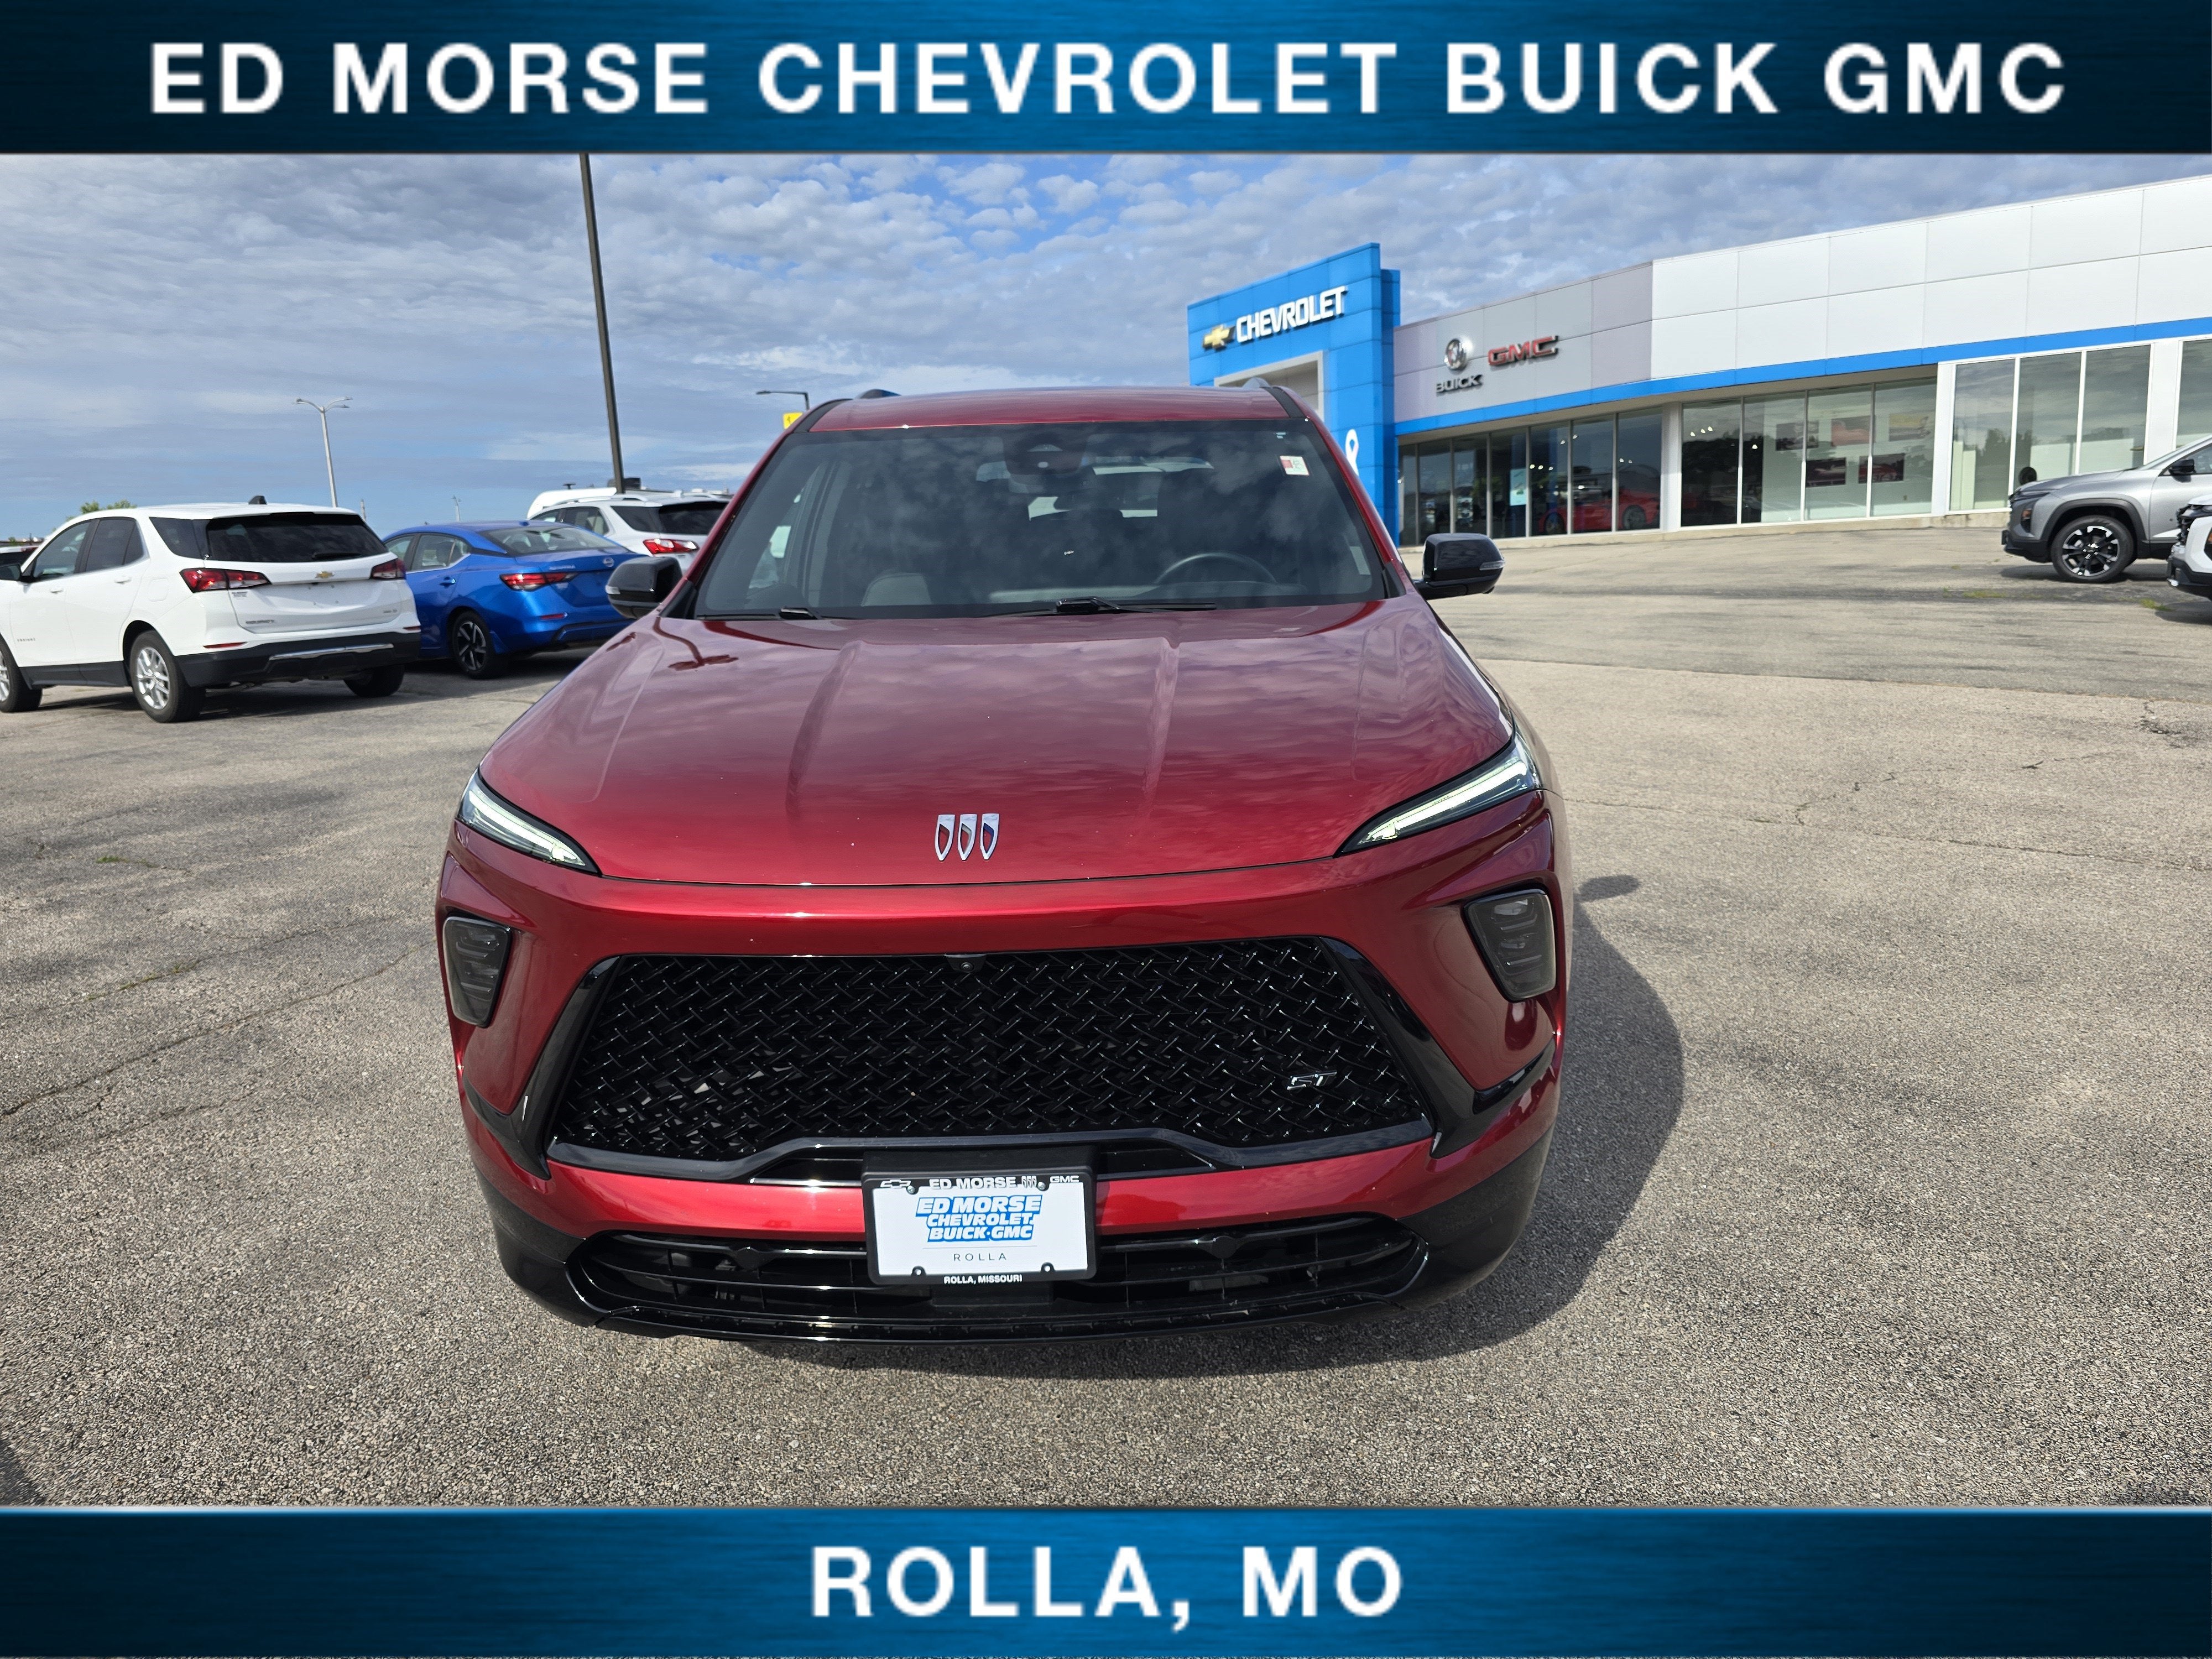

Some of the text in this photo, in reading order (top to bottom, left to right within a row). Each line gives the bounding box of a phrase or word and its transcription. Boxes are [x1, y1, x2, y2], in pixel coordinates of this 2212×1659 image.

[1236, 285, 1348, 343] CHEVROLET
[1488, 336, 1559, 366] GMC
[1436, 374, 1483, 393] BUICK
[929, 1176, 1016, 1190] ED MORSE
[916, 1195, 1042, 1214] ED MORSE
[927, 1213, 1033, 1227] CHEVROLET
[953, 1253, 1006, 1261] ROLLA
[943, 1274, 1022, 1285] ROLLA, MISSOURI
